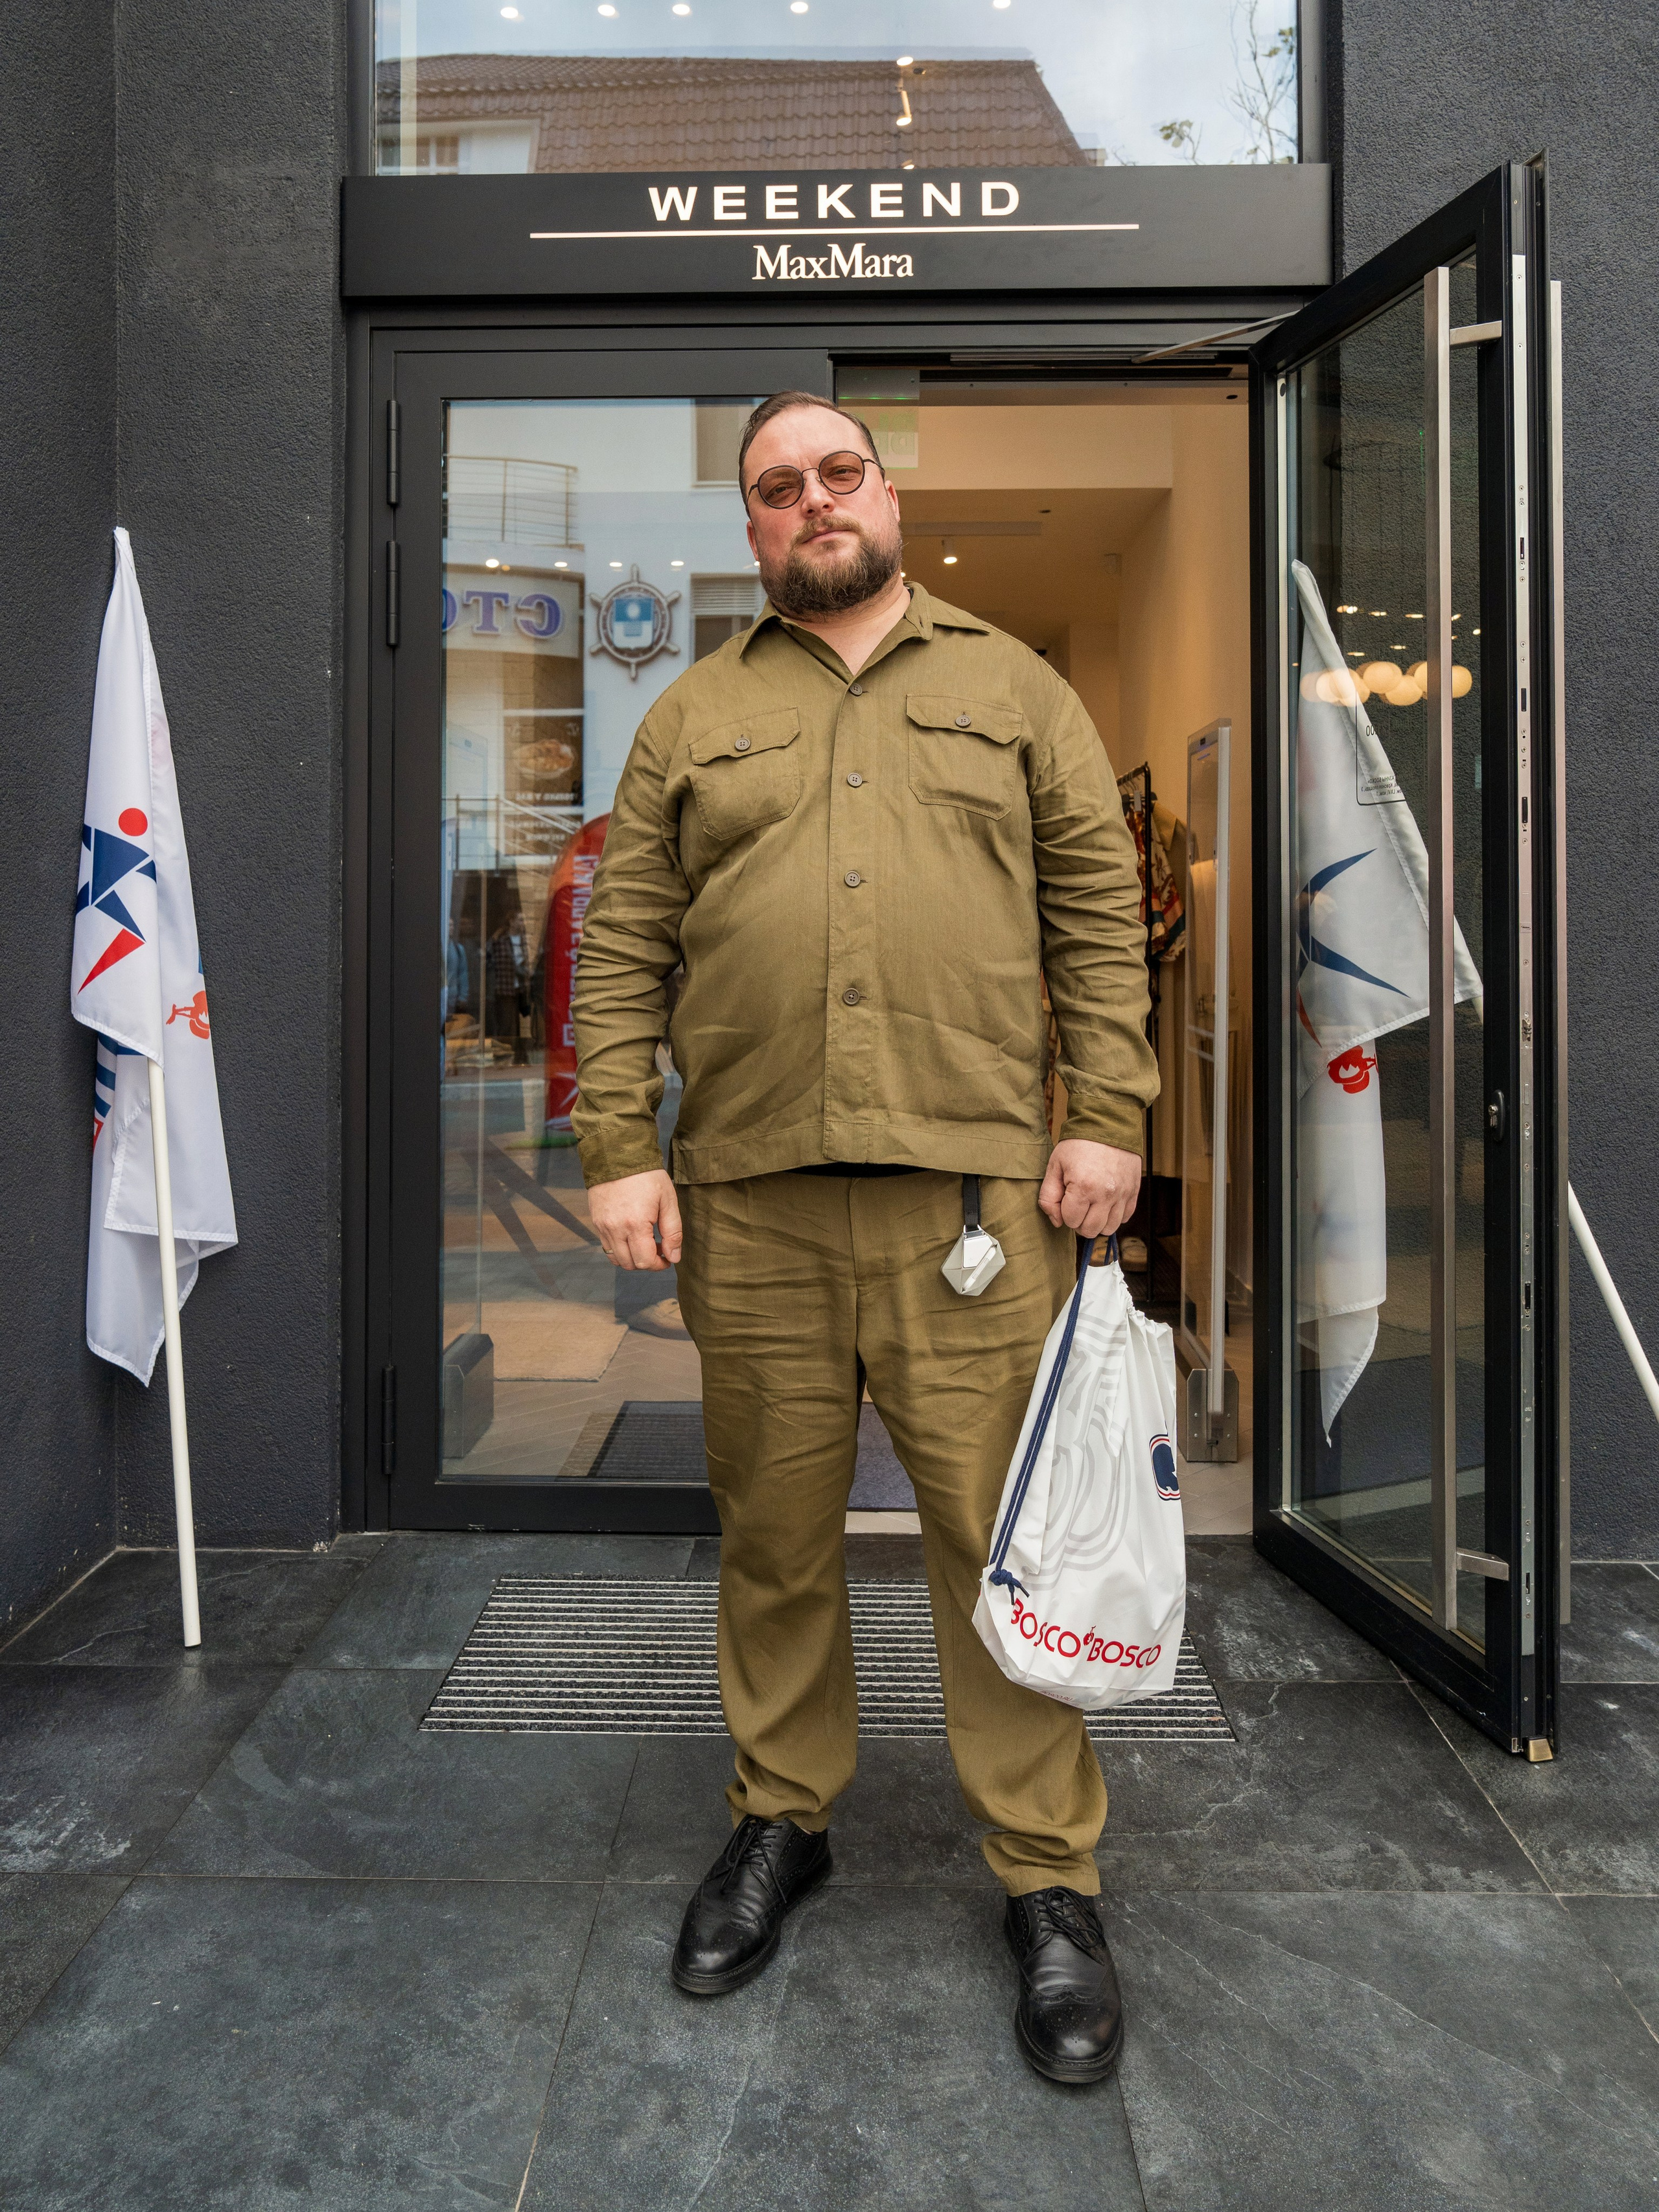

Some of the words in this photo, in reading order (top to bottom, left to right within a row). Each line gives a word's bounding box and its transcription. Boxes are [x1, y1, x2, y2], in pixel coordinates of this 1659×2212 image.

[648, 181, 1019, 221] WEEKEND
[752, 242, 914, 280] MaxMara
[1011, 1598, 1081, 1658] BOSCO
[1087, 1638, 1162, 1669] BOSCO
